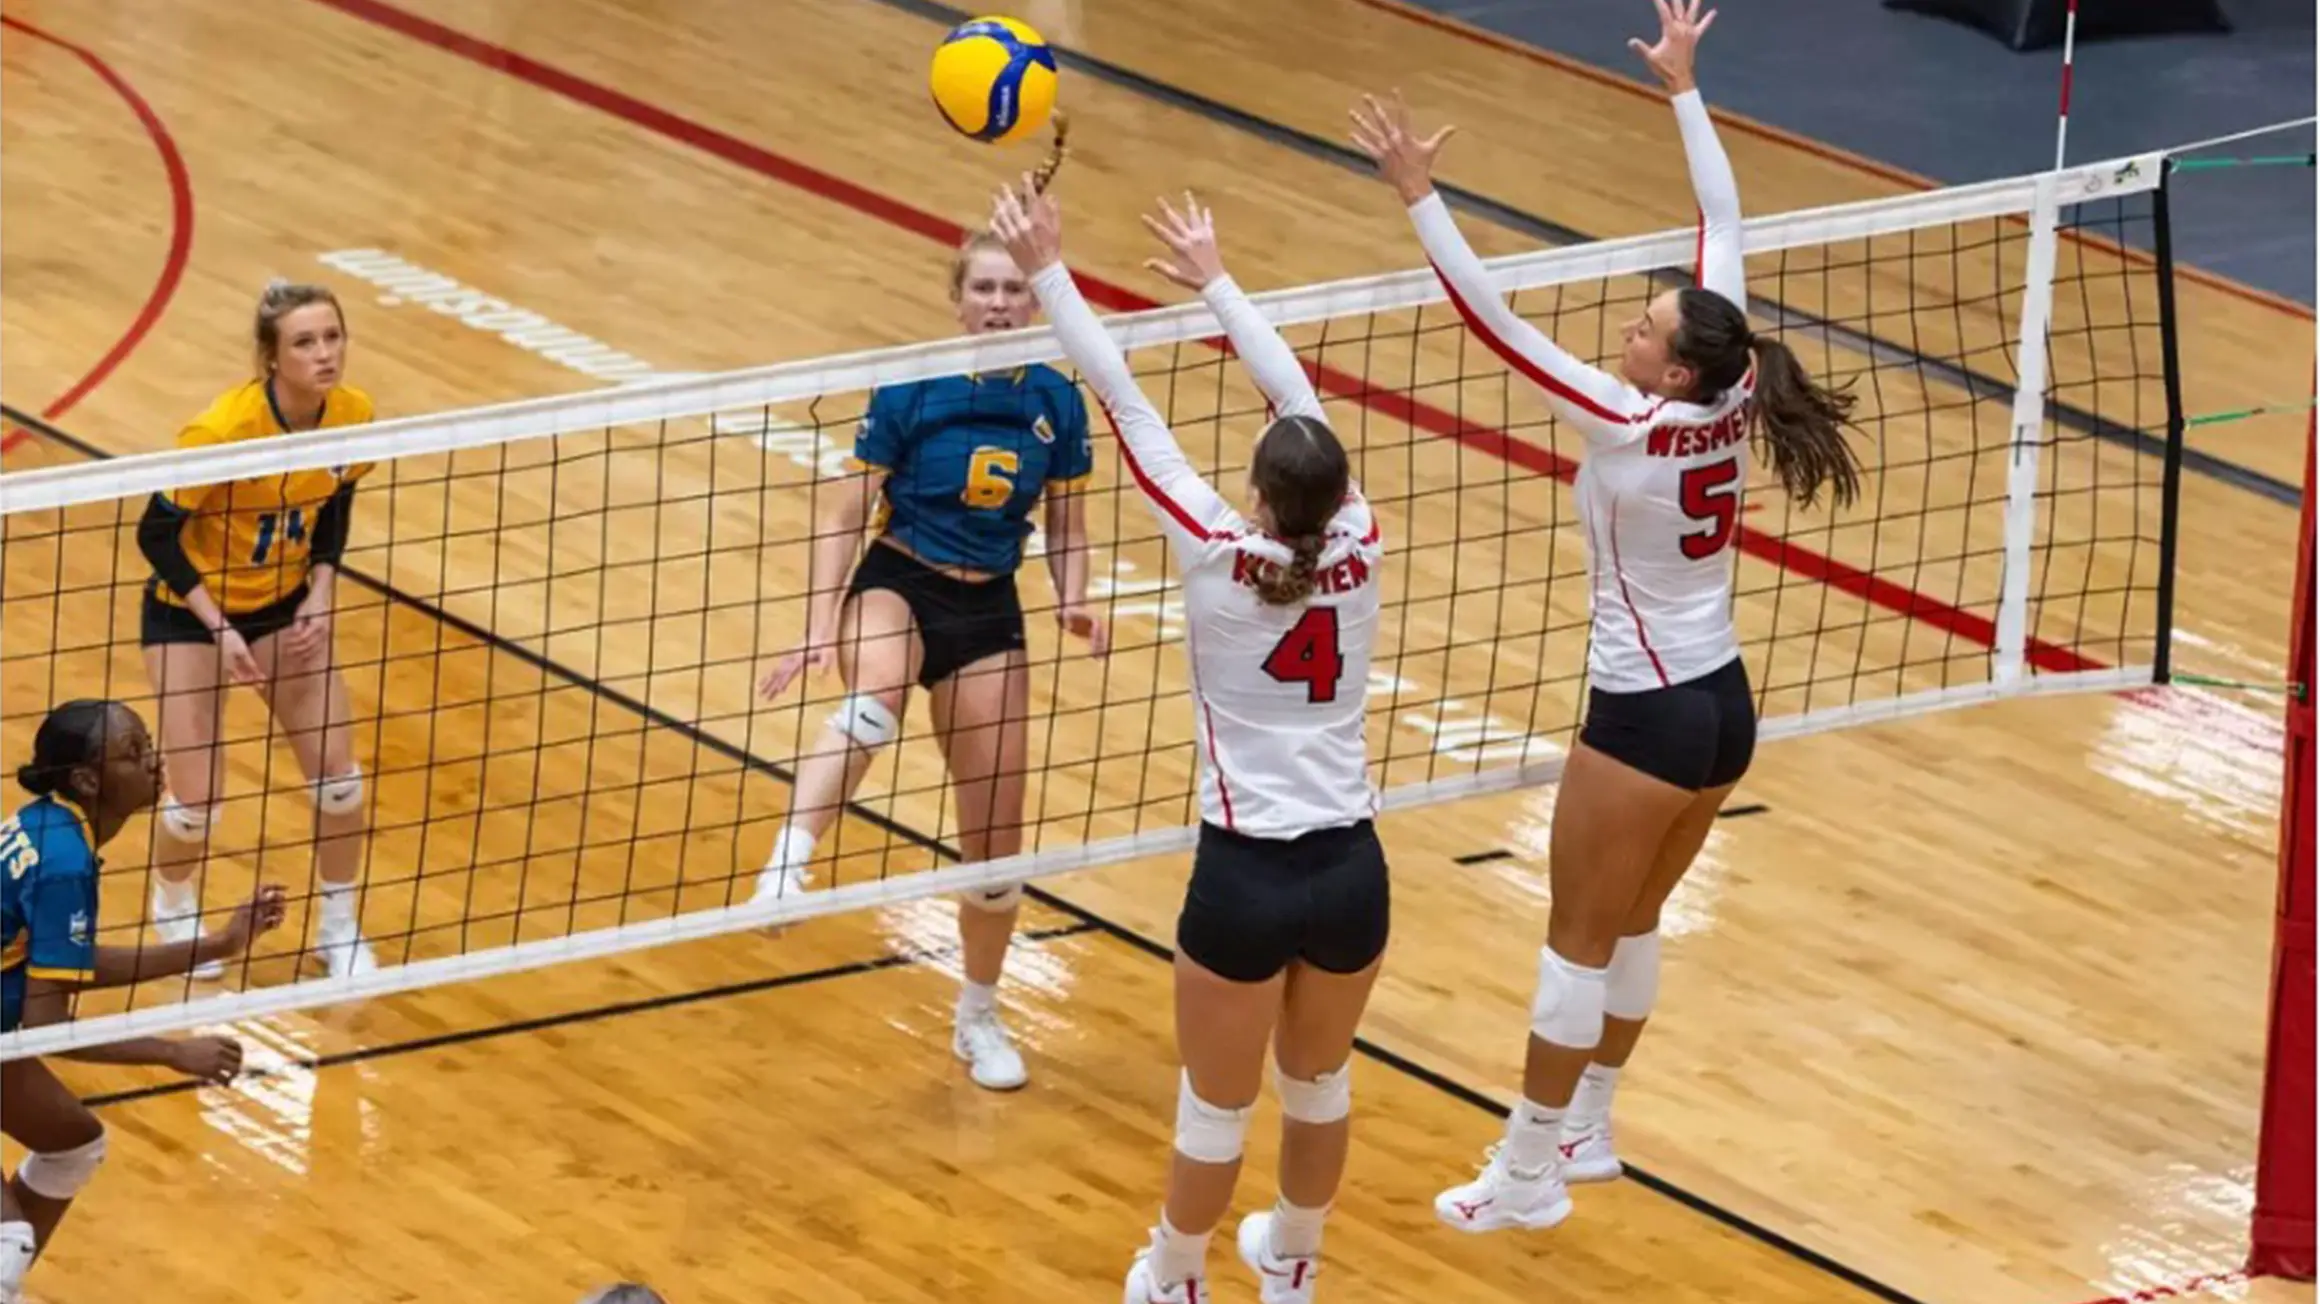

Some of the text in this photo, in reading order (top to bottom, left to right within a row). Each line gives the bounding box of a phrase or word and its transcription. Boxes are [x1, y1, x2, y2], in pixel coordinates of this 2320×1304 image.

[1646, 404, 1748, 457] WESME
[962, 445, 1020, 510] 6
[1679, 457, 1738, 561] 5
[1260, 605, 1344, 704] 4
